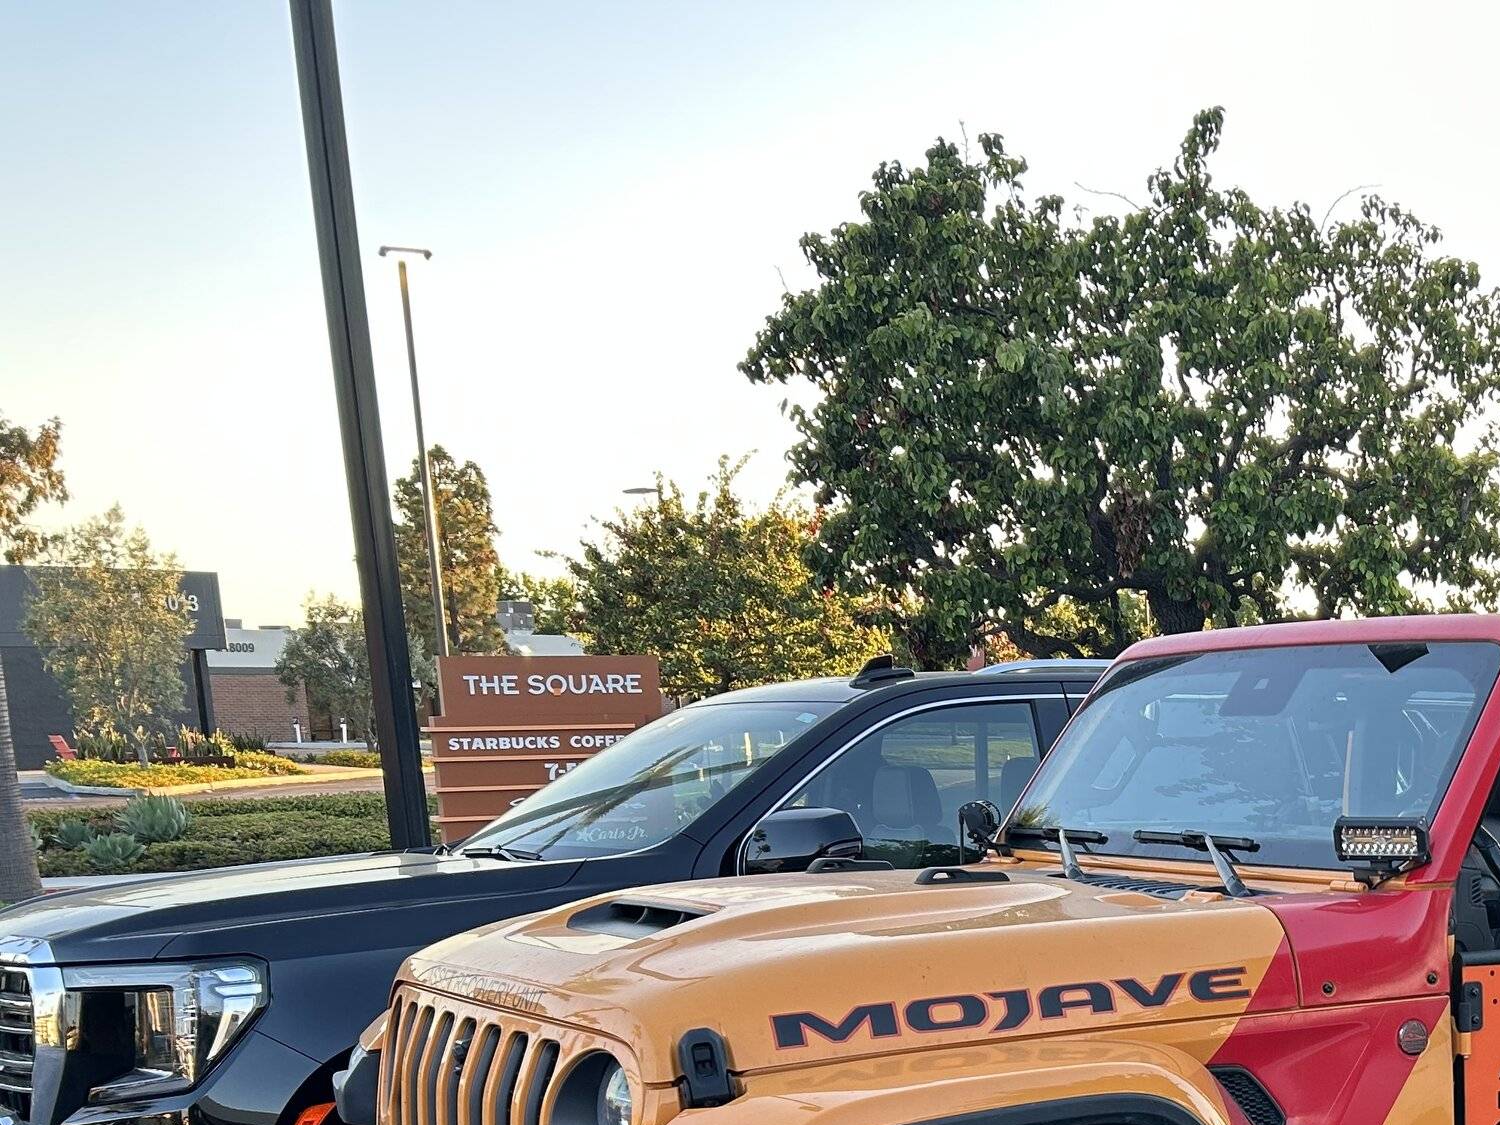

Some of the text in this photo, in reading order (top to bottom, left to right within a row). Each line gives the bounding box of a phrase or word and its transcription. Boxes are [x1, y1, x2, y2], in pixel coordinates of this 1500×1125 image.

[226, 642, 255, 653] 8009
[463, 674, 643, 696] THE SQUARE
[448, 735, 560, 750] STARBUCKS
[770, 966, 1252, 1050] MOJAVE
